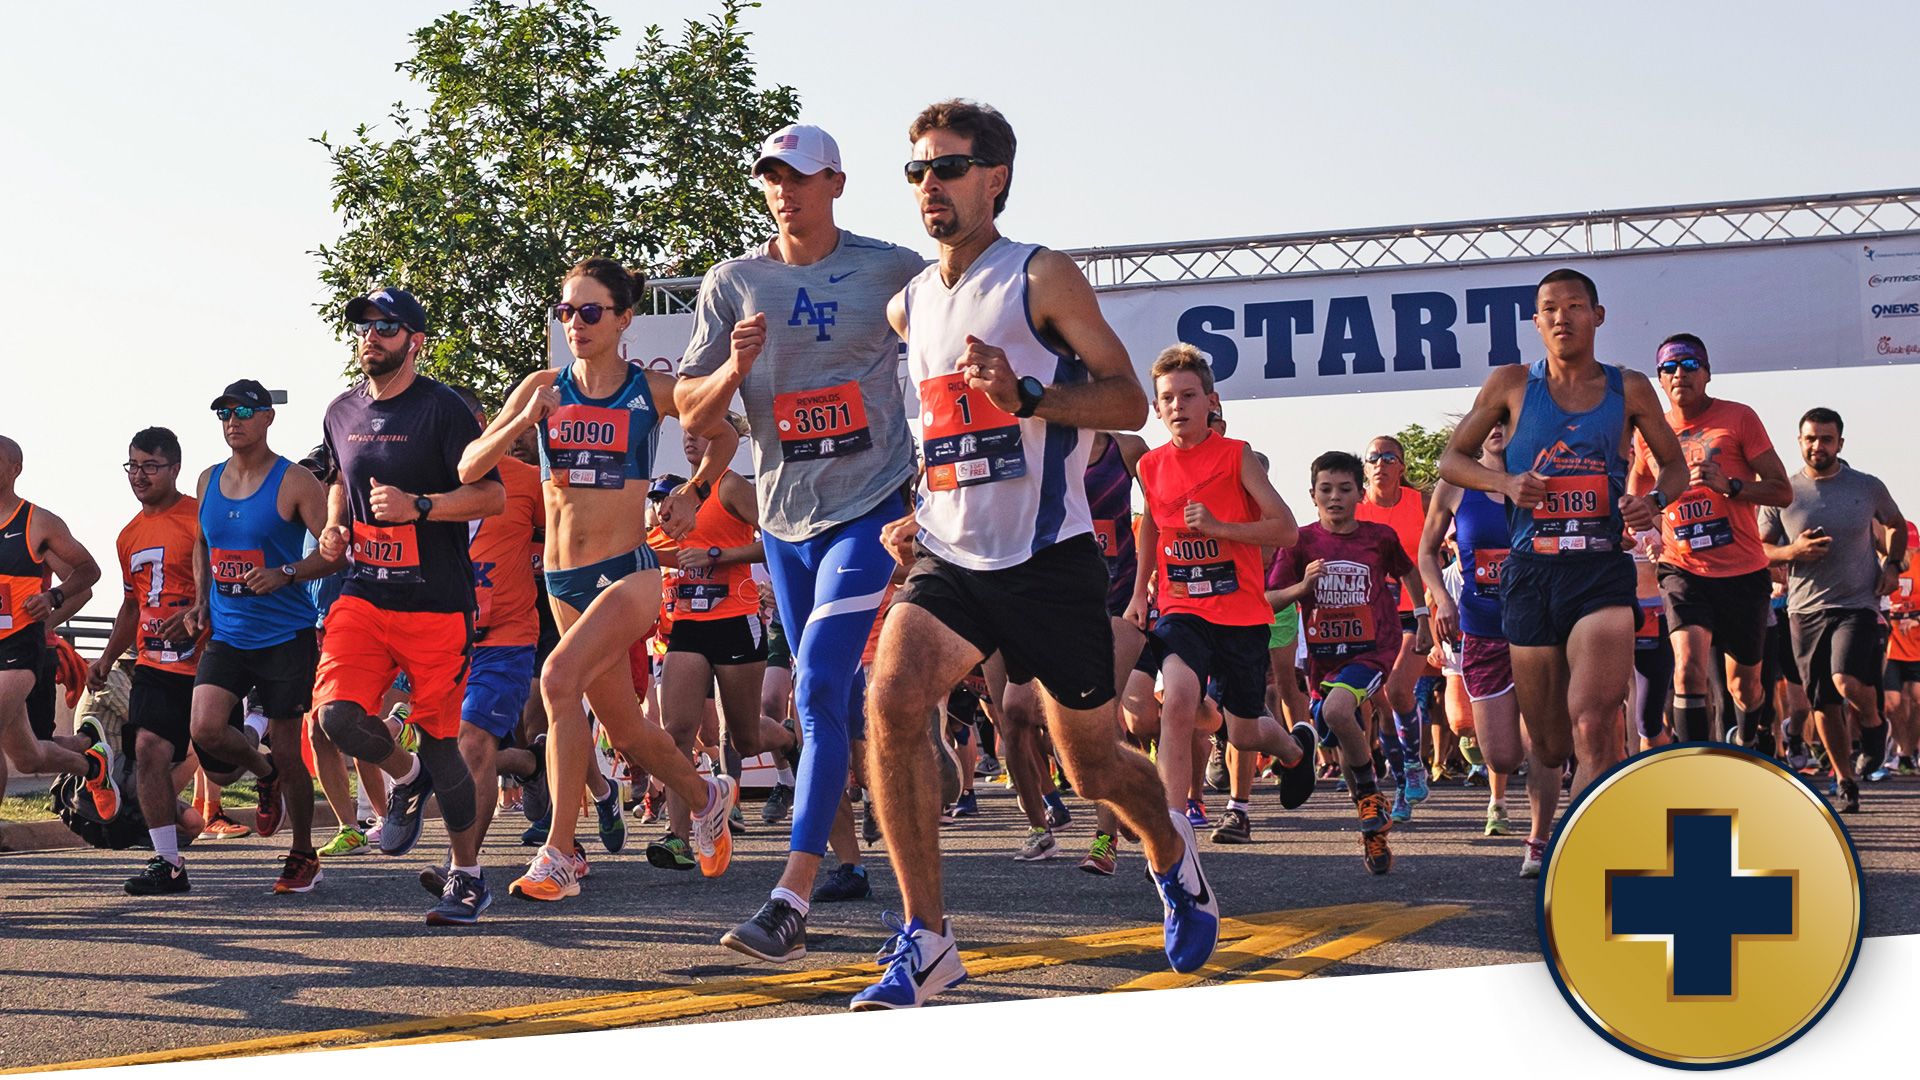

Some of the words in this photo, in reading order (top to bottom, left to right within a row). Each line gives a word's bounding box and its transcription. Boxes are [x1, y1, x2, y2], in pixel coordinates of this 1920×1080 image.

[787, 286, 839, 342] AF
[1871, 303, 1920, 319] 9NEWS
[1177, 285, 1537, 383] START
[797, 393, 841, 407] REYNOLDS
[955, 393, 972, 426] 1
[795, 402, 851, 434] 3671
[560, 420, 615, 445] 5090
[820, 438, 836, 455] fit
[959, 434, 978, 457] fit
[1546, 490, 1597, 513] 5189
[1678, 499, 1713, 521] 1702
[364, 540, 404, 562] 4727
[1173, 538, 1219, 561] 4000
[1328, 565, 1358, 574] AMERICAN
[1317, 575, 1366, 592] NINJA
[1317, 590, 1366, 605] WARRIOR
[1319, 619, 1363, 639] 3576
